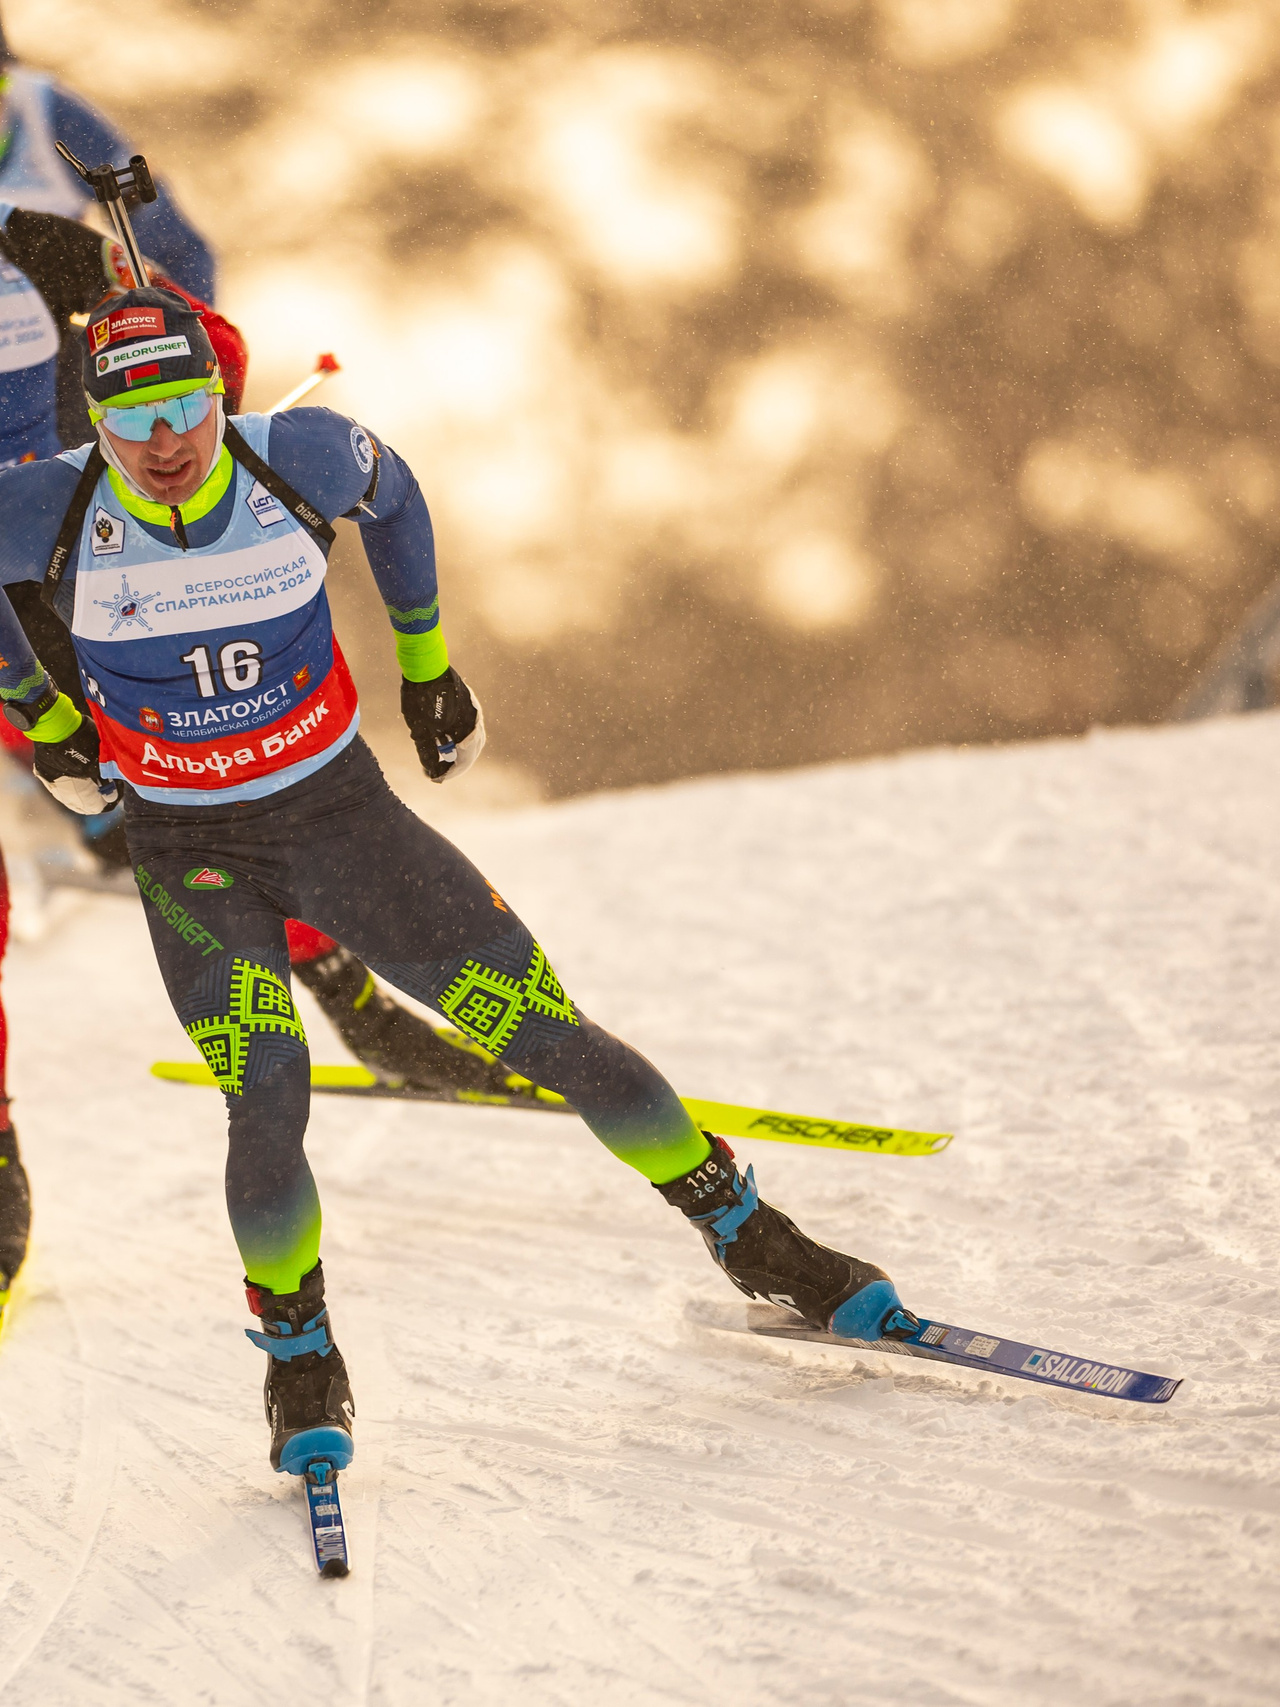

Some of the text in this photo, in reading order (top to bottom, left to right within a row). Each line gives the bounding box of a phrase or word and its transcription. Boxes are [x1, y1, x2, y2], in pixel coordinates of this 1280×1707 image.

[111, 316, 156, 329] ЗЛАТОУСТ
[113, 341, 187, 363] BELORUSNEFT
[294, 502, 323, 529] biatar
[154, 568, 312, 613] СПАРТАКИАДА 2024
[184, 555, 307, 595] ВСЕРОССИЙСКАЯ
[180, 640, 263, 698] 16
[167, 680, 289, 728] ЗЛАТОУСТ
[172, 698, 292, 738] ЧЕЛЯБИНСКАЯ ОБЛАСТЬ
[140, 700, 330, 778] Альфа Банк
[134, 864, 225, 957] BELORUSNEFT
[748, 1113, 894, 1148] FISCHER
[686, 1160, 718, 1188] 116
[1037, 1354, 1134, 1394] SALOMON
